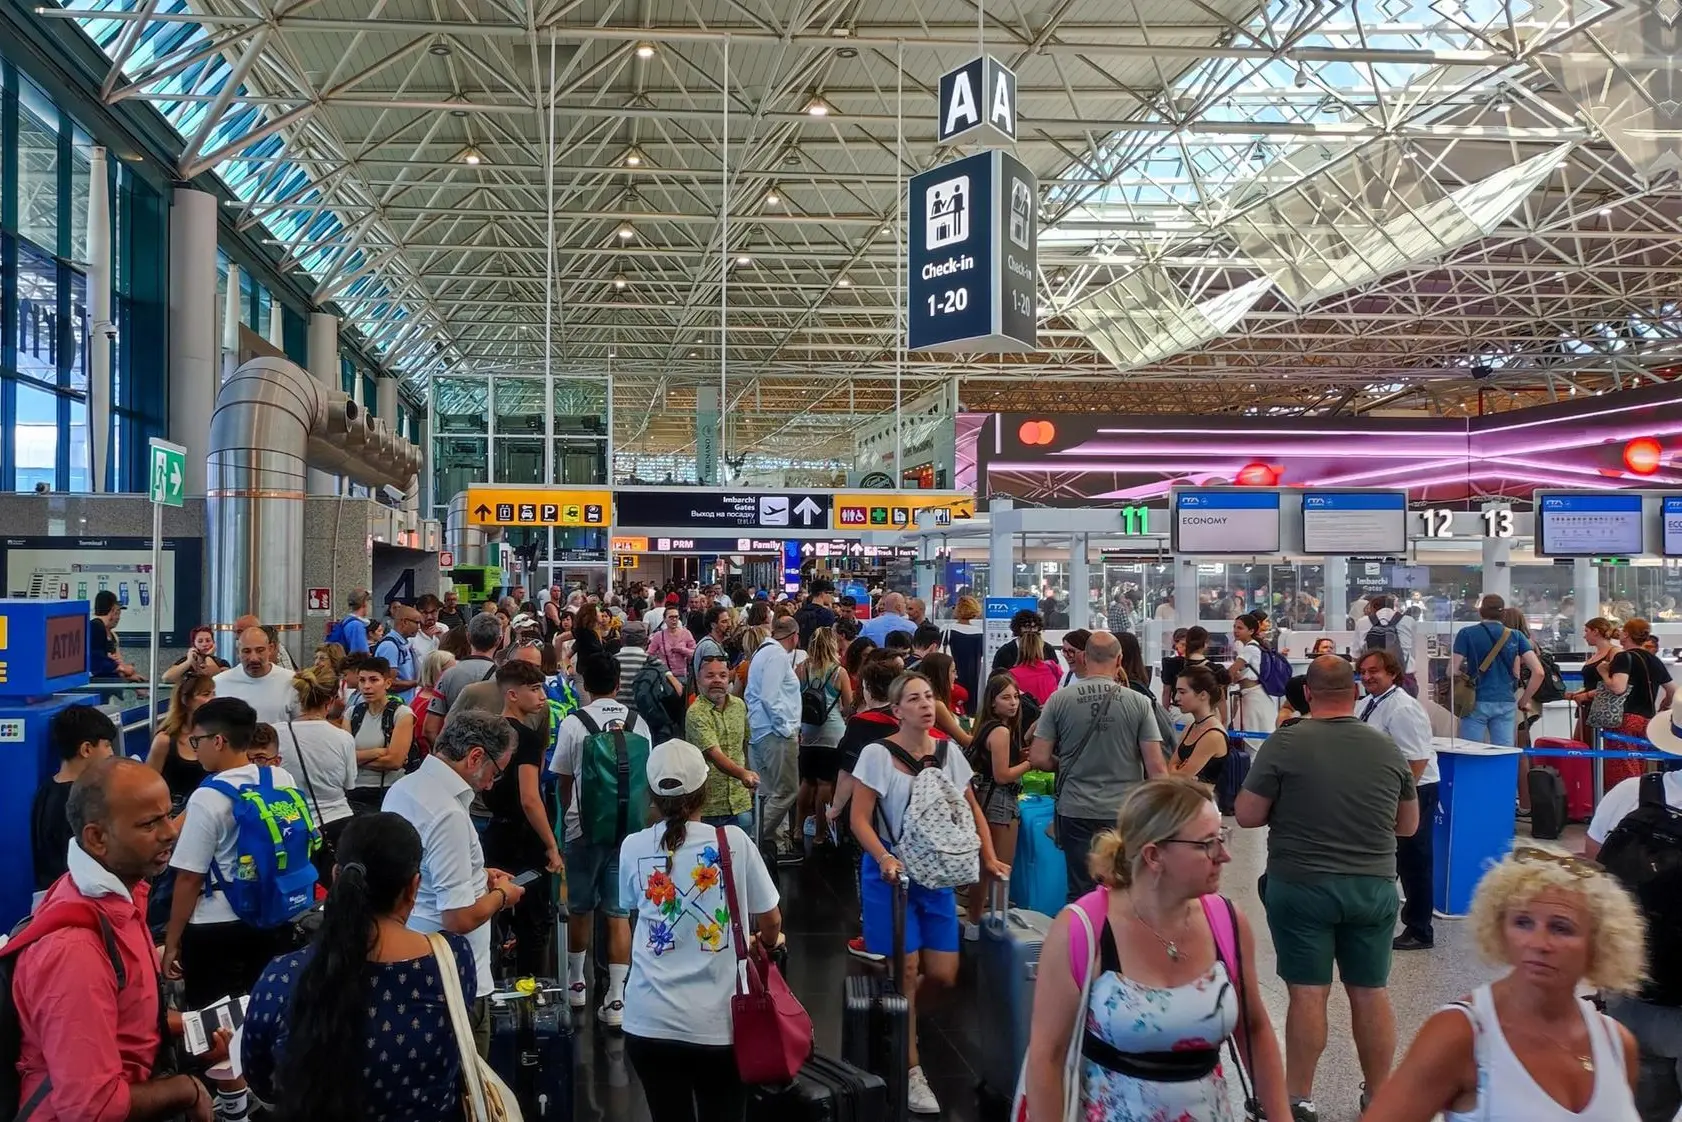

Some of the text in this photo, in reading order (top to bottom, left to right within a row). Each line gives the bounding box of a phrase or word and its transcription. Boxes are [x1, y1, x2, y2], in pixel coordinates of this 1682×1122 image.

[944, 71, 979, 134] A
[990, 70, 1013, 134] A
[921, 254, 974, 280] Check-in
[1007, 255, 1032, 281] Check-in
[927, 287, 968, 317] 1-20
[1012, 288, 1031, 318] 1-20
[1123, 506, 1148, 536] 11
[1182, 517, 1228, 525] ECONOMY
[1423, 508, 1453, 538] 12
[1485, 509, 1514, 538] 13
[672, 540, 694, 549] PRM
[752, 540, 781, 551] Family
[384, 568, 419, 605] 4
[1356, 577, 1388, 585] Imbarchi
[52, 630, 81, 660] ATM
